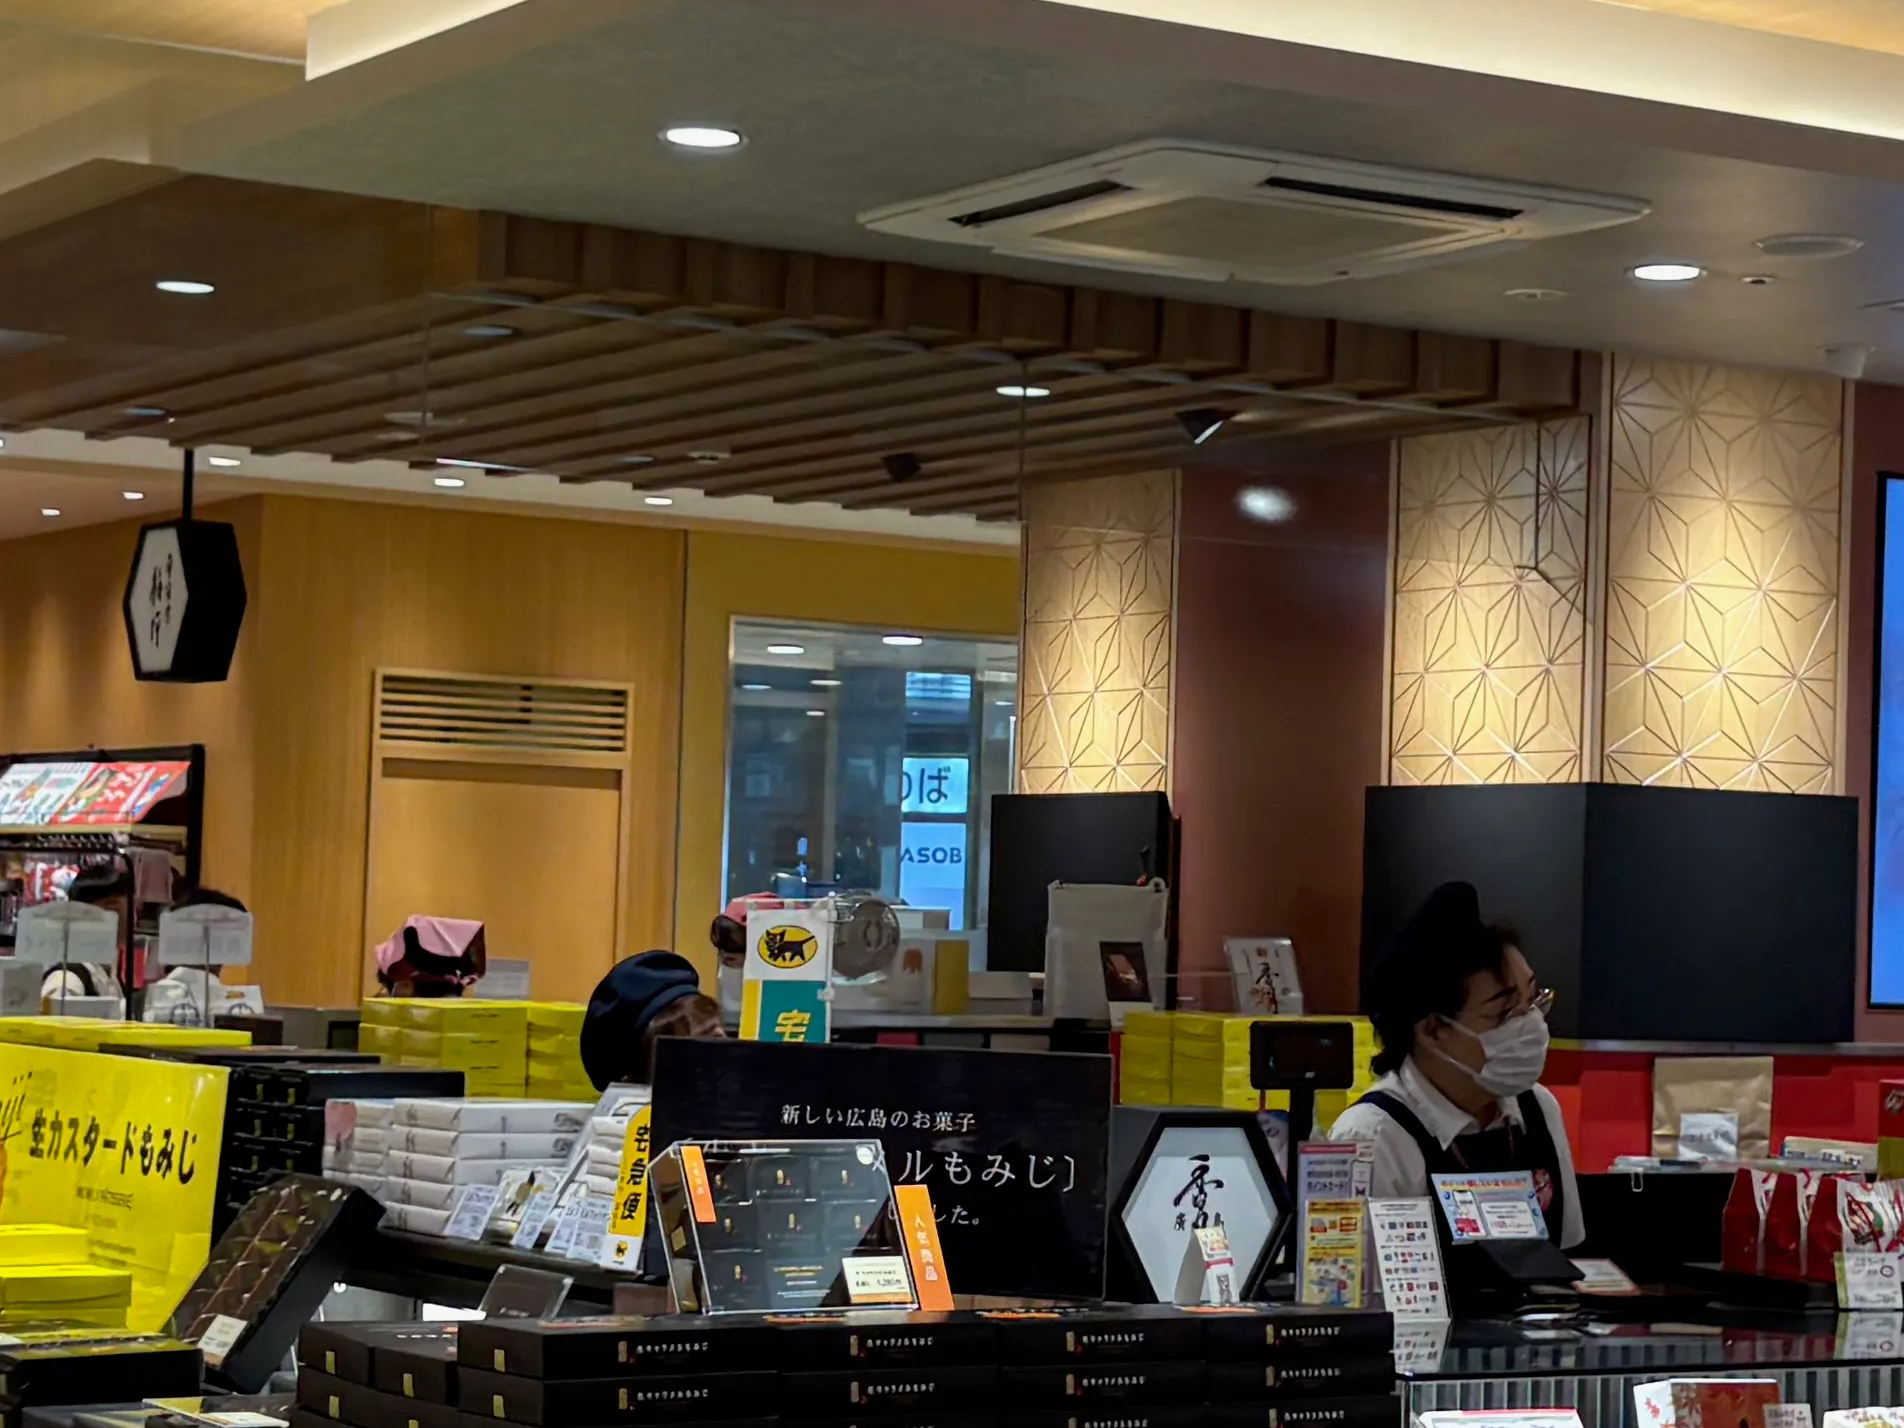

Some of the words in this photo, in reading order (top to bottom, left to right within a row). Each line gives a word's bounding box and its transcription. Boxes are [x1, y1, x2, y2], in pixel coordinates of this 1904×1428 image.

[780, 1103, 976, 1133] 新しい広島のお菓子
[29, 1107, 197, 1185] 生カスタードもみじ
